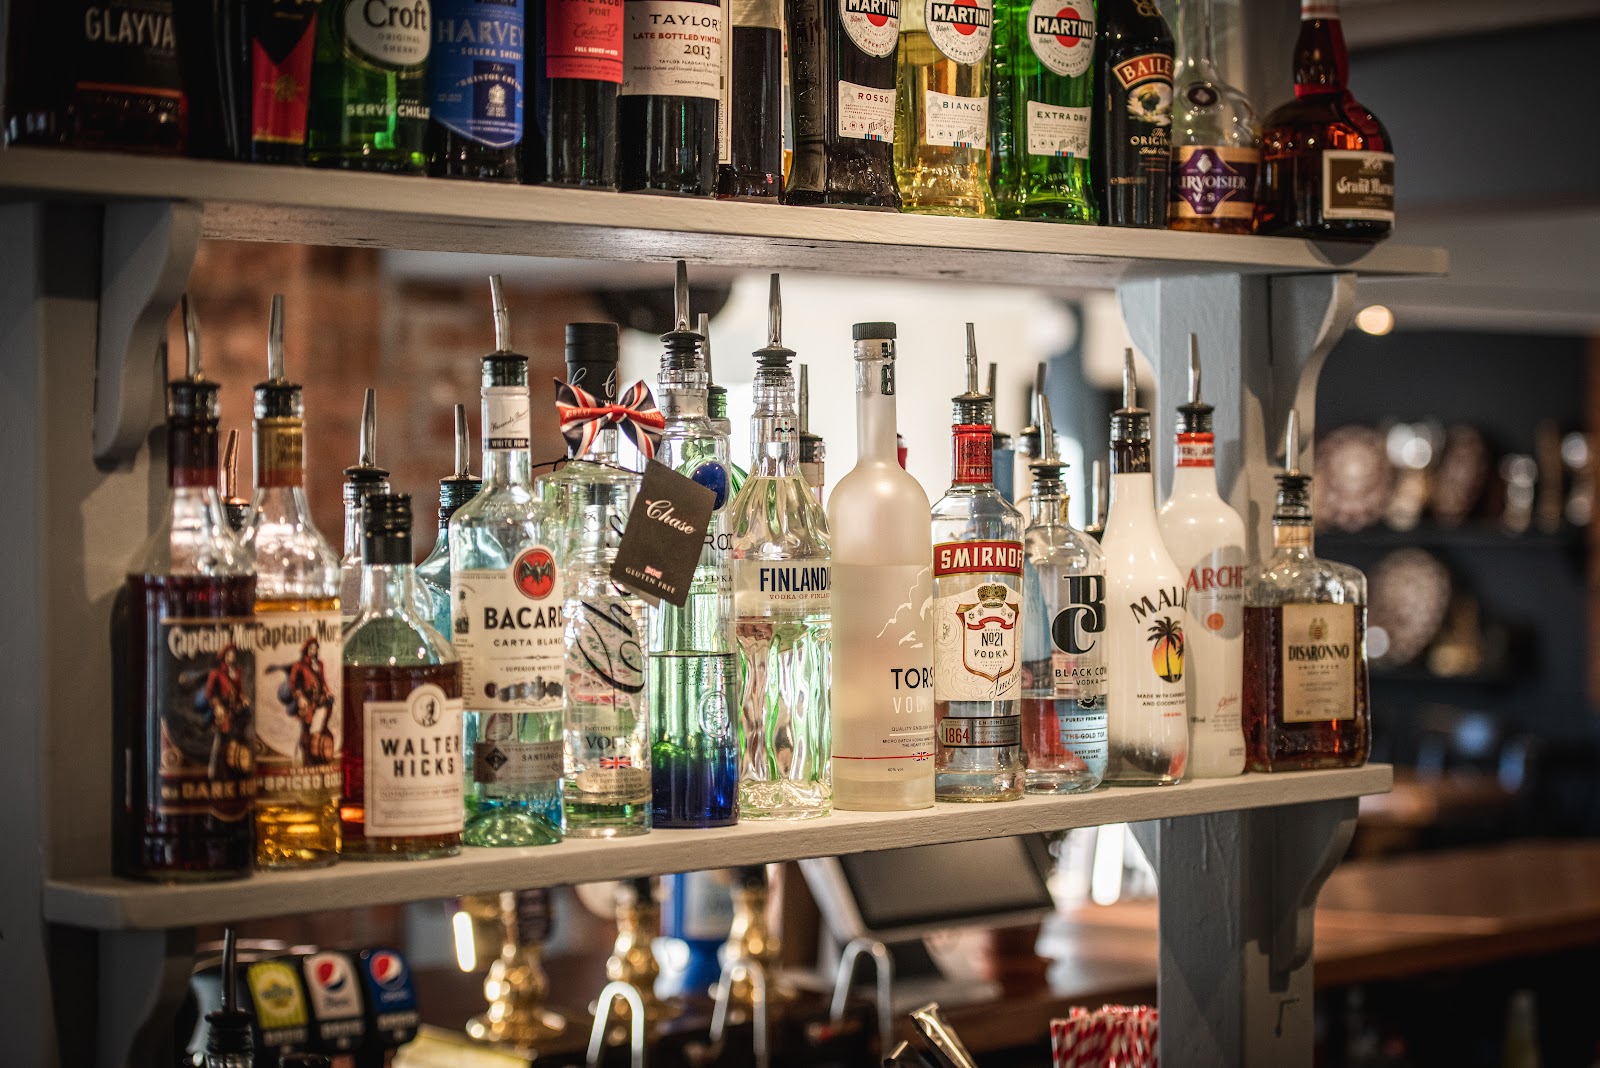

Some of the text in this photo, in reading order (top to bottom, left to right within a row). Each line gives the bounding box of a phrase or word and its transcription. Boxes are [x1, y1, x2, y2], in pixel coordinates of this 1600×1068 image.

[363, 0, 427, 32] Croft
[588, 7, 611, 17] PORT
[848, 0, 899, 17] MARTINI
[933, 4, 990, 27] MARTINI
[1036, 16, 1093, 39] MARTINI
[633, 32, 655, 40] LATE
[658, 32, 698, 41] BOTTLED
[460, 46, 496, 57] SOLERA
[683, 44, 711, 60] 2013
[857, 92, 889, 104] ROSSO
[942, 101, 982, 112] BIANCO
[1036, 111, 1088, 123] EXTRA DRY
[491, 439, 526, 448] WHITE RUM
[645, 498, 697, 536] Chase
[625, 565, 656, 585] GLUTEN
[657, 580, 676, 595] FREE
[167, 625, 231, 660] Captain
[255, 620, 312, 652] Captain
[493, 639, 532, 647] CARTA
[973, 648, 1009, 659] VODKA
[1288, 643, 1350, 662] DISARONNO
[505, 665, 535, 673] SUPERIOR
[1055, 667, 1092, 678] BLACK
[890, 666, 934, 690] TORS
[1075, 678, 1100, 686] VODKA
[585, 725, 611, 733] ENGLISH
[945, 727, 970, 744] 1864
[380, 734, 459, 756] WALTER
[393, 757, 455, 778] HICKS
[263, 774, 322, 791] SPICED
